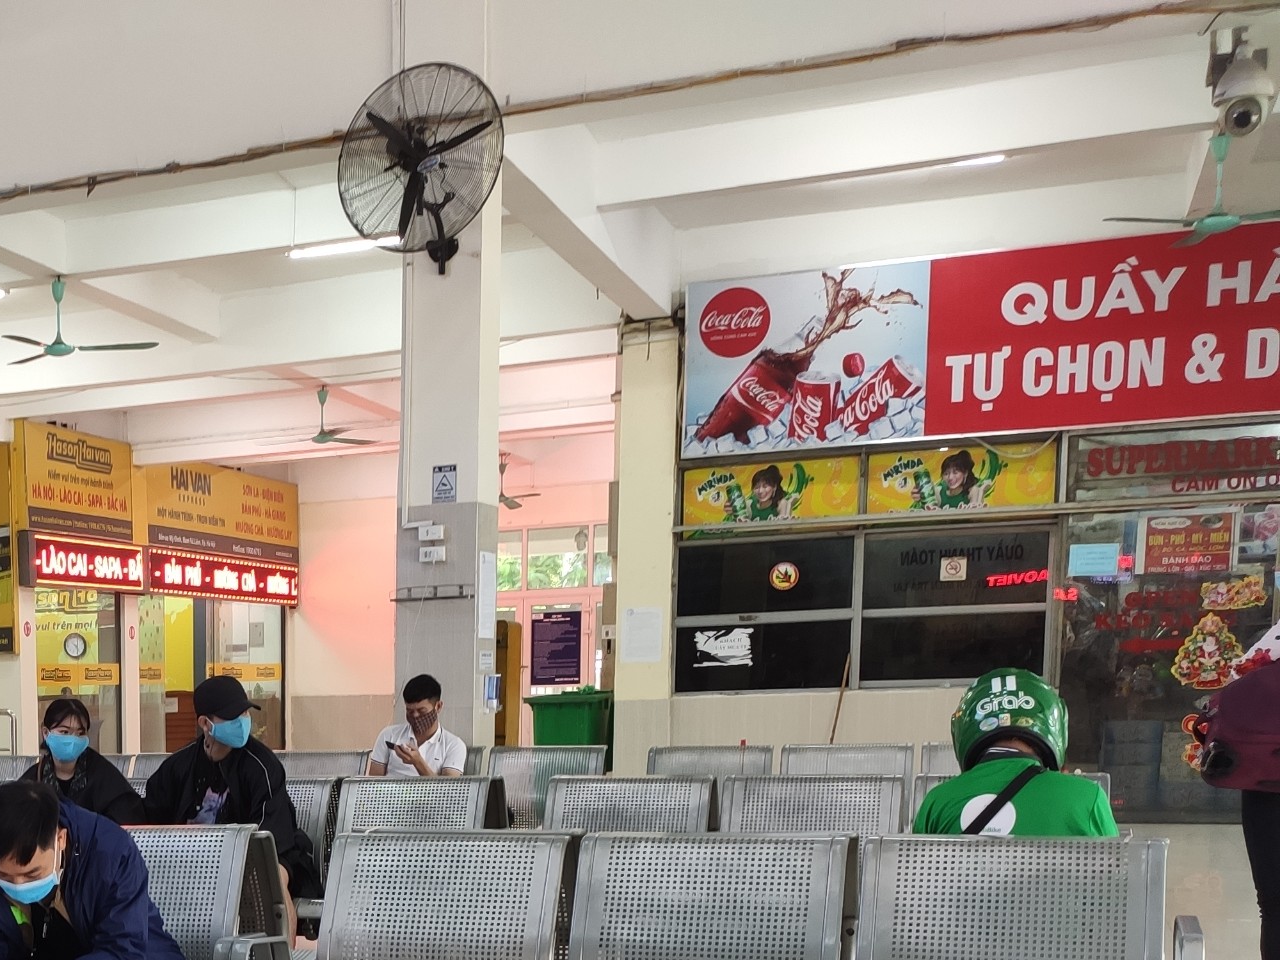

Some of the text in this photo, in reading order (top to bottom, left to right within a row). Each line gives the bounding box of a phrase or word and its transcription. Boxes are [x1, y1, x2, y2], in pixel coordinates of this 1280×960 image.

[1001, 255, 1187, 326] QUẦY
[701, 305, 767, 333] Coca-Cola
[945, 345, 1012, 412] TỰ
[1022, 336, 1166, 403] CHỌN
[1184, 332, 1225, 384] &
[739, 376, 785, 412] Coca-Cola
[697, 469, 735, 496] MIRINDA
[882, 456, 923, 482] MIRINDA
[32, 481, 42, 499] HÀ
[59, 484, 72, 505] LÀO
[73, 490, 84, 507] CAI
[87, 493, 104, 510] SAPA
[41, 545, 123, 580] LÀO CAI SAPA
[975, 691, 1036, 715] Grab
